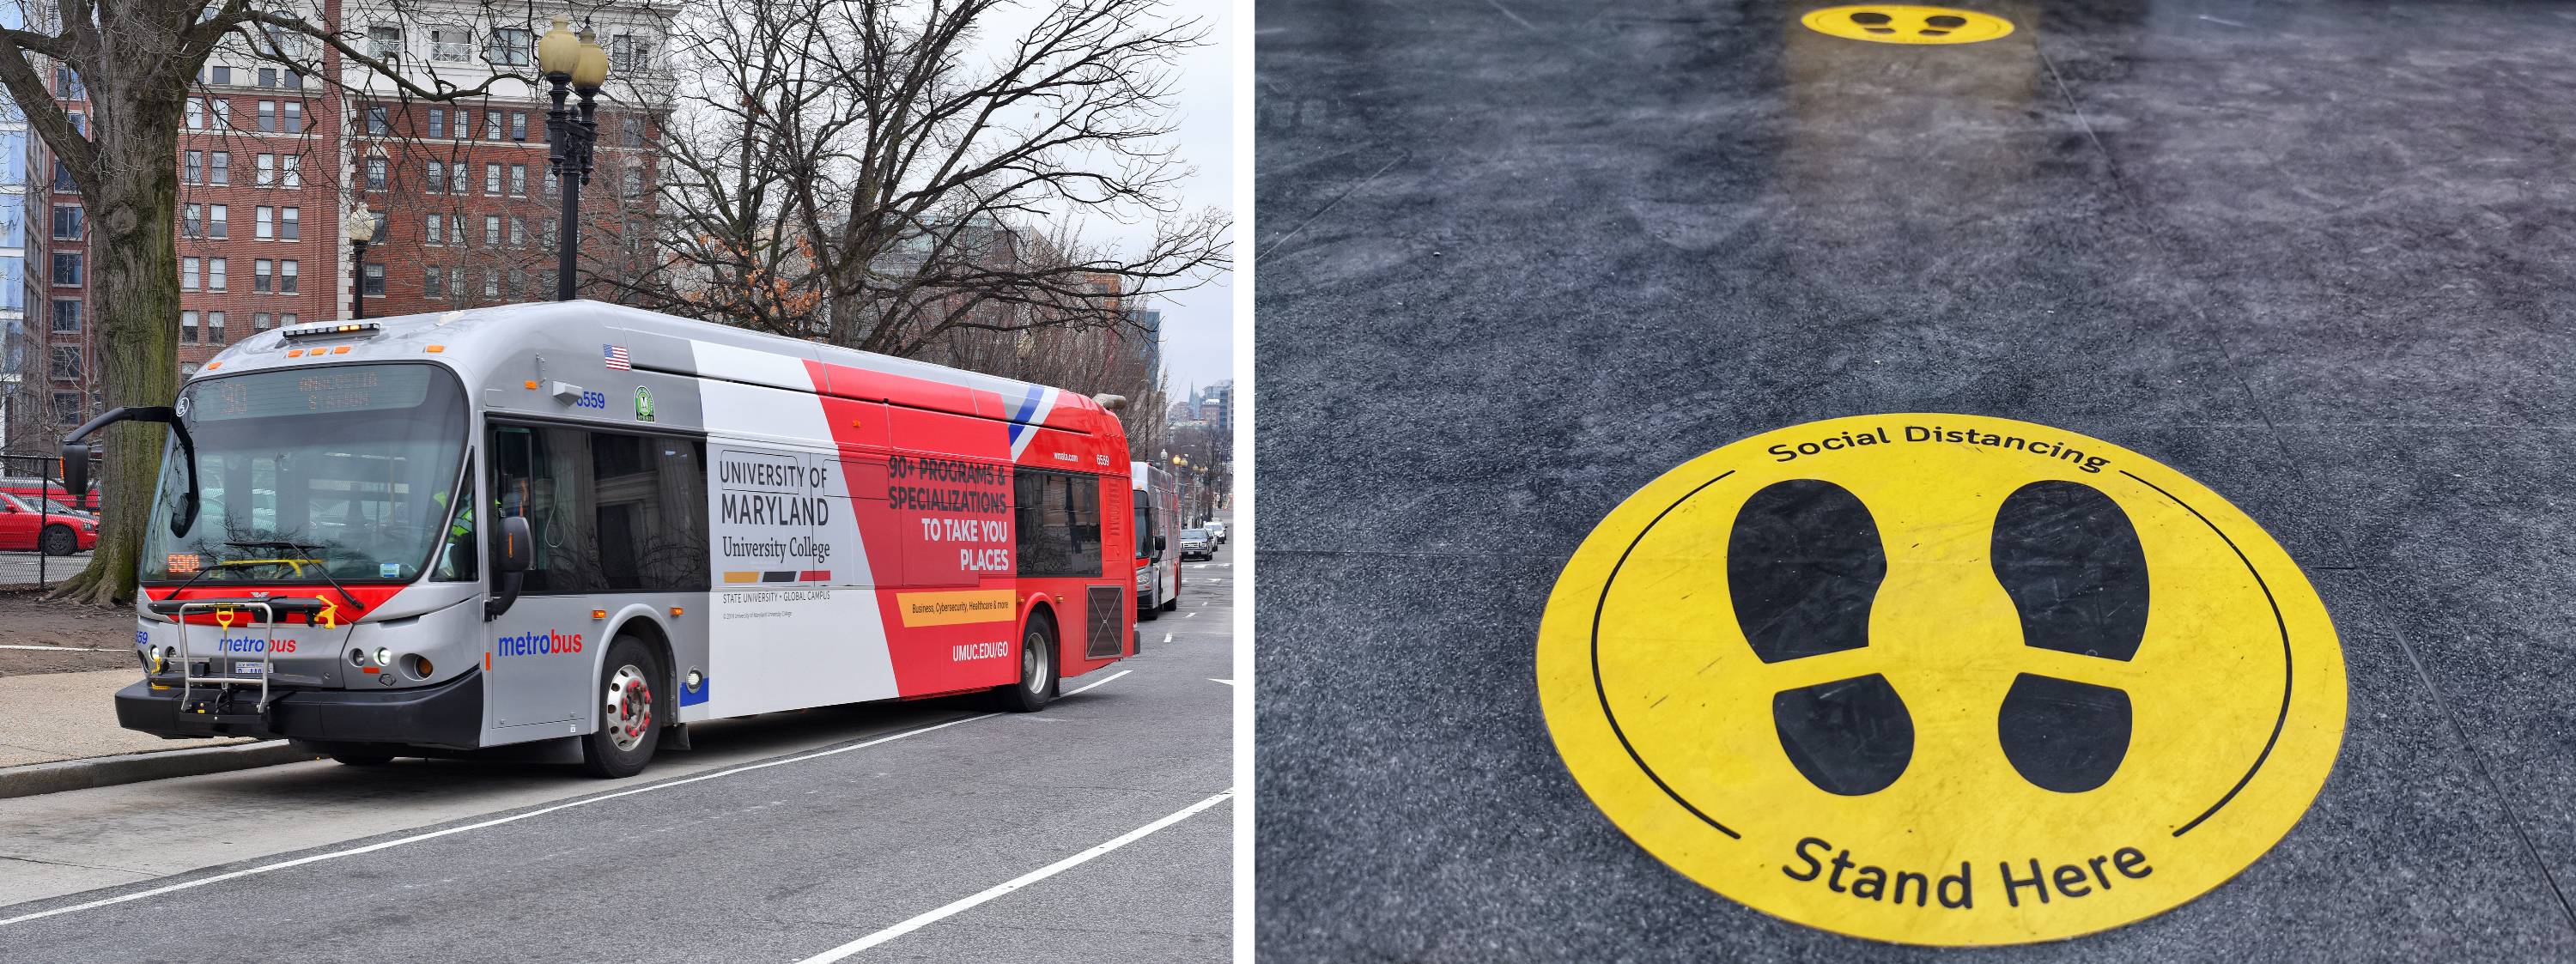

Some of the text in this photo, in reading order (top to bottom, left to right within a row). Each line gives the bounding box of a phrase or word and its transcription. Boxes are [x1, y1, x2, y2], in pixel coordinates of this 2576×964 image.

[222, 381, 246, 415] 90
[309, 391, 368, 409] STATION
[1053, 452, 1078, 463] wmata.com
[1097, 453, 1109, 466] 6559
[1767, 426, 2111, 475] Social Distancing
[720, 460, 828, 488] UNIVERSITY OF
[888, 454, 1005, 486] 90+ PROGRAMS &
[721, 493, 829, 526] MARYLAND
[889, 486, 1007, 514] SPECIALIZATIONS
[921, 518, 1007, 543] TO TAKE YOU
[723, 536, 830, 564] University College
[960, 549, 1009, 571] PLACES
[723, 591, 830, 603] STATE UNIVERSITY GLOBAL CAMPUS
[912, 600, 1008, 615] Business, Cybersecurity, Healthcare & more
[498, 629, 582, 657] metrobus
[952, 641, 1009, 662] UMUC.EDU/GO
[1782, 836, 2154, 910] Stand Here
